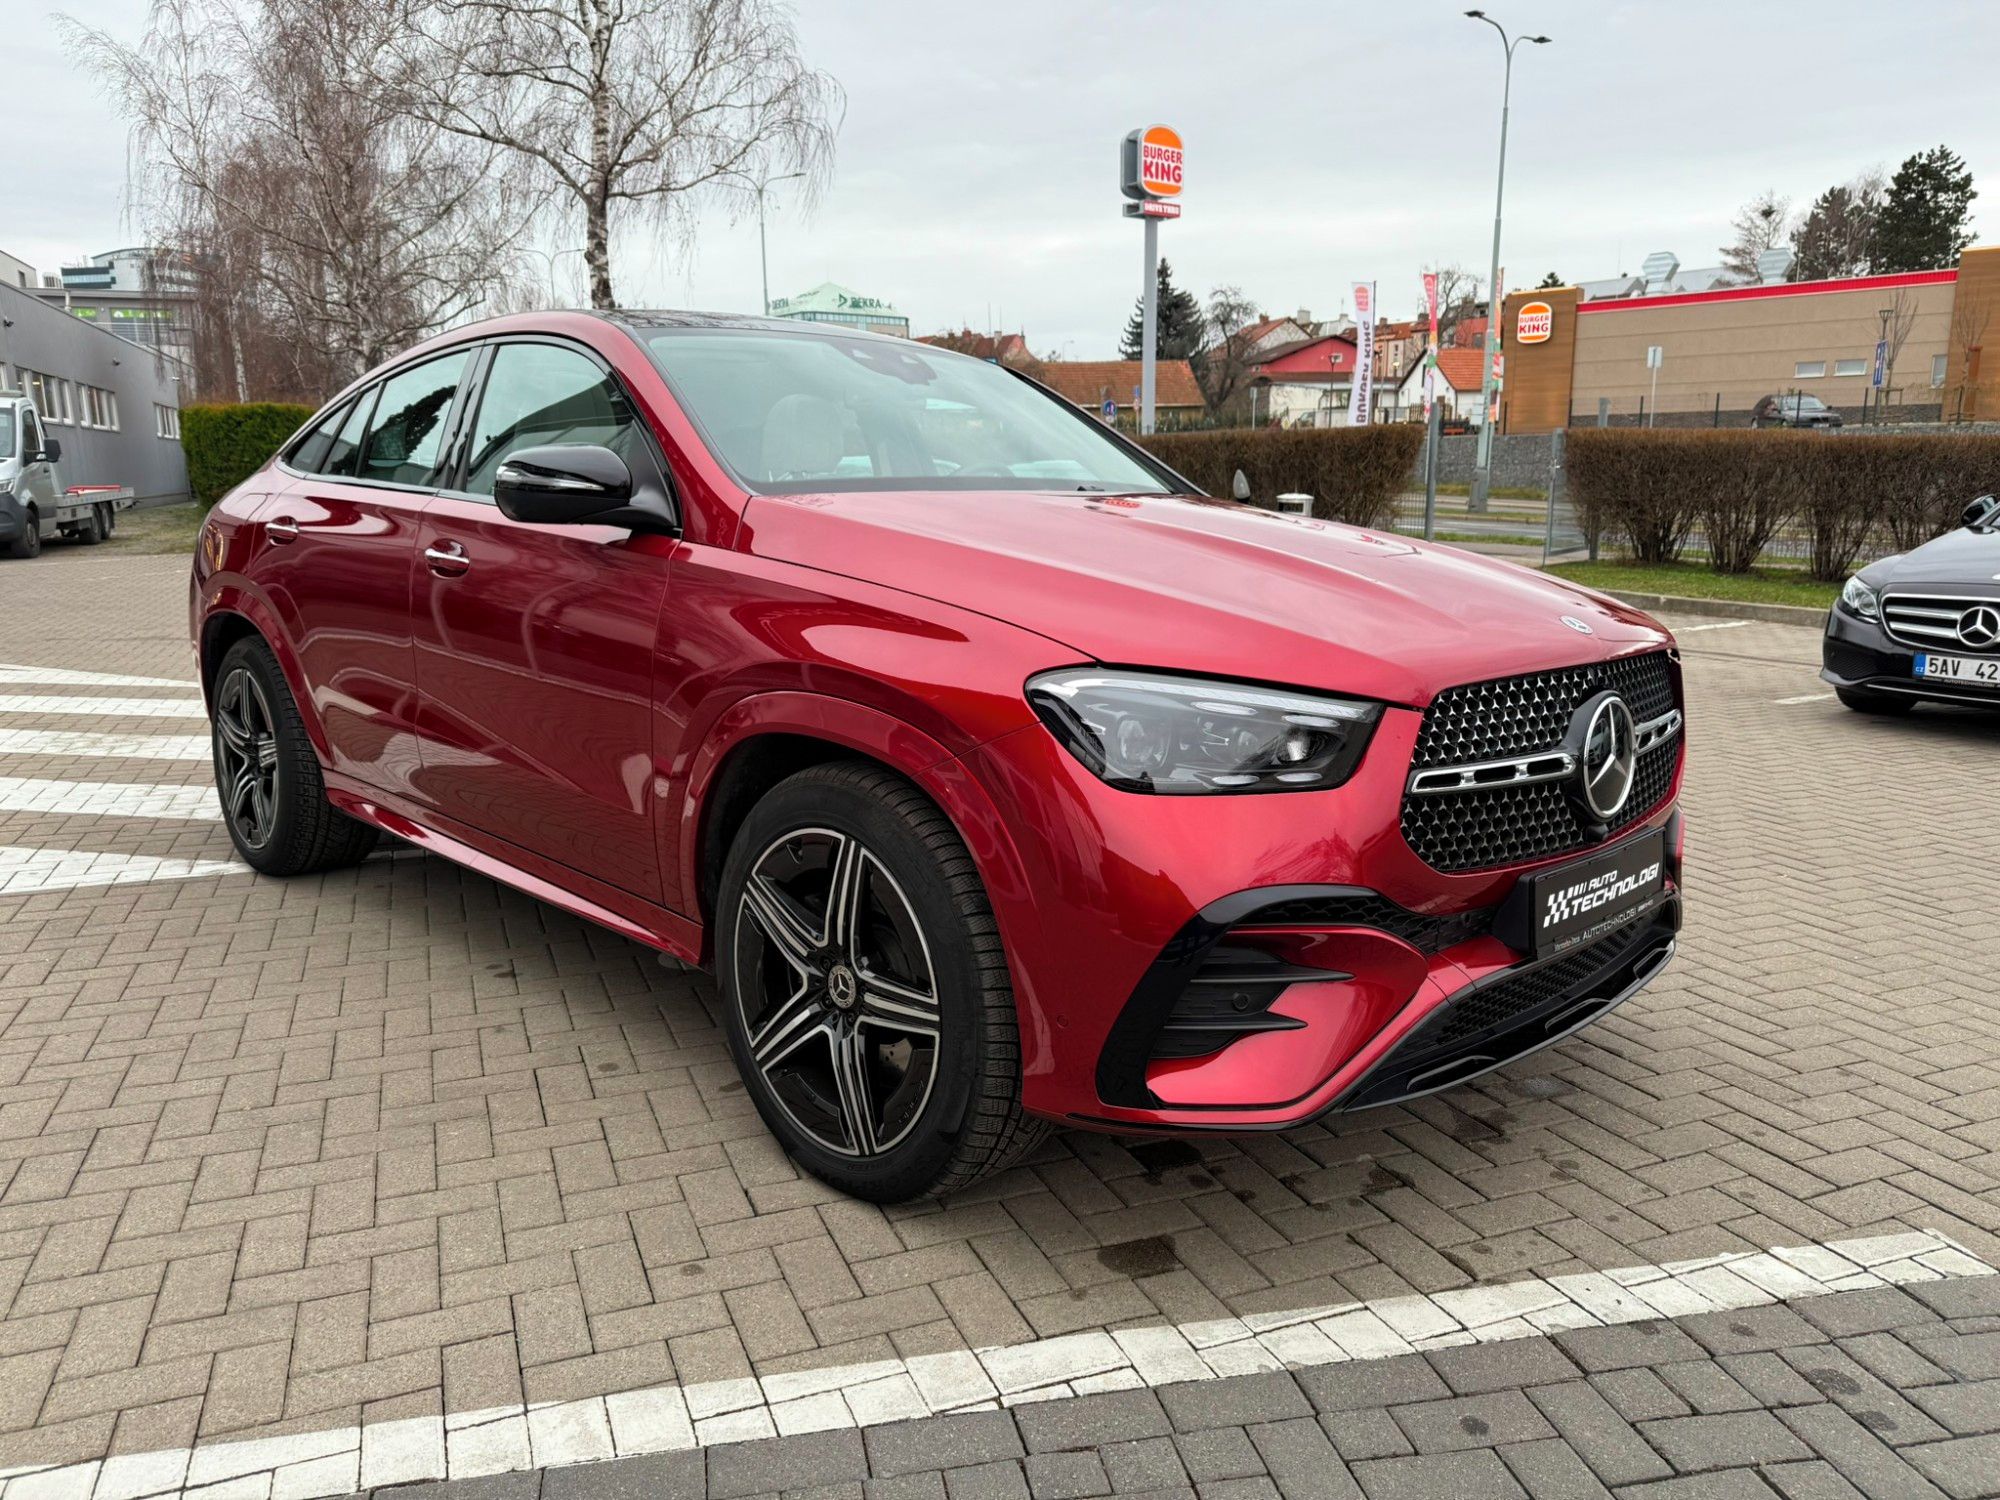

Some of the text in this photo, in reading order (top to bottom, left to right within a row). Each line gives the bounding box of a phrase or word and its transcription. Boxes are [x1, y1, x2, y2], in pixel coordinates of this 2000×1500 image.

[1143, 145, 1182, 165] BURGER
[1143, 160, 1182, 183] KING
[849, 297, 882, 309] DEKRA
[1519, 315, 1550, 323] BURGER
[1519, 323, 1549, 334] KING
[1929, 658, 1999, 680] 5AV 42
[1571, 862, 1660, 916] TECHNOLOGI
[1588, 869, 1618, 891] AUTO
